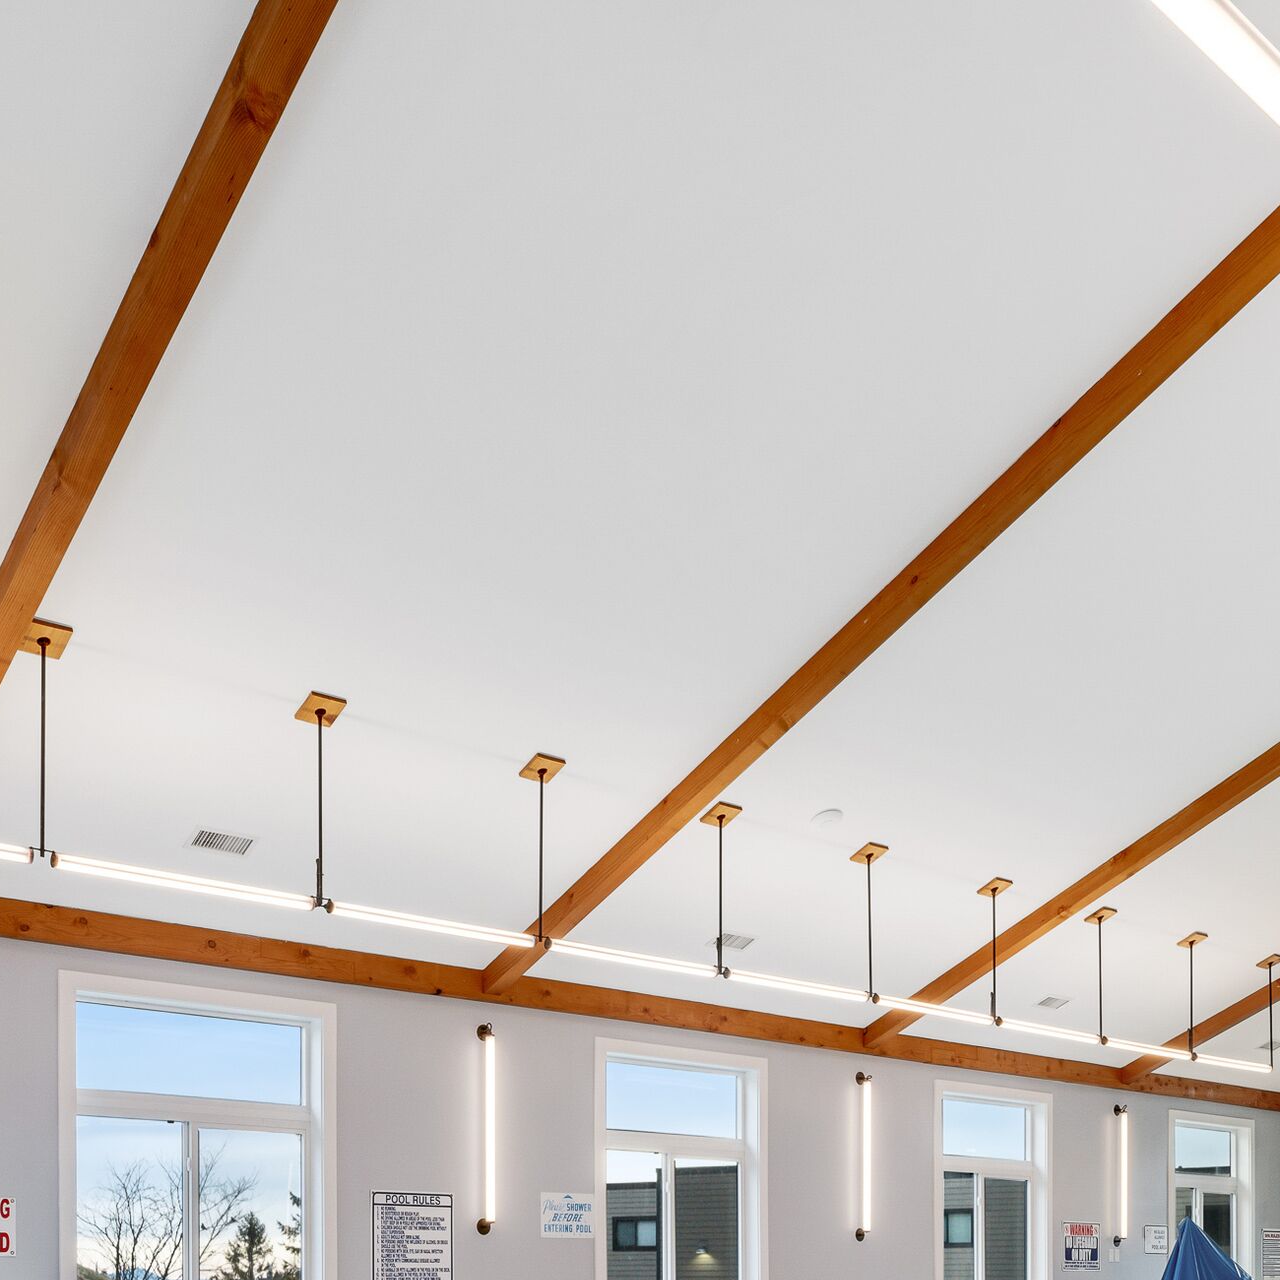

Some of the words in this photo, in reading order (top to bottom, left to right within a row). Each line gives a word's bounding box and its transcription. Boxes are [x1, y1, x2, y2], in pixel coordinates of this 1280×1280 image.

[385, 1194, 410, 1204] POOL
[412, 1195, 441, 1205] RULES
[566, 1203, 592, 1212] SHOWER
[552, 1212, 584, 1222] BEFORE
[543, 1223, 573, 1232] ENTERING
[575, 1224, 592, 1233] POOL
[1070, 1224, 1094, 1236] WARNING
